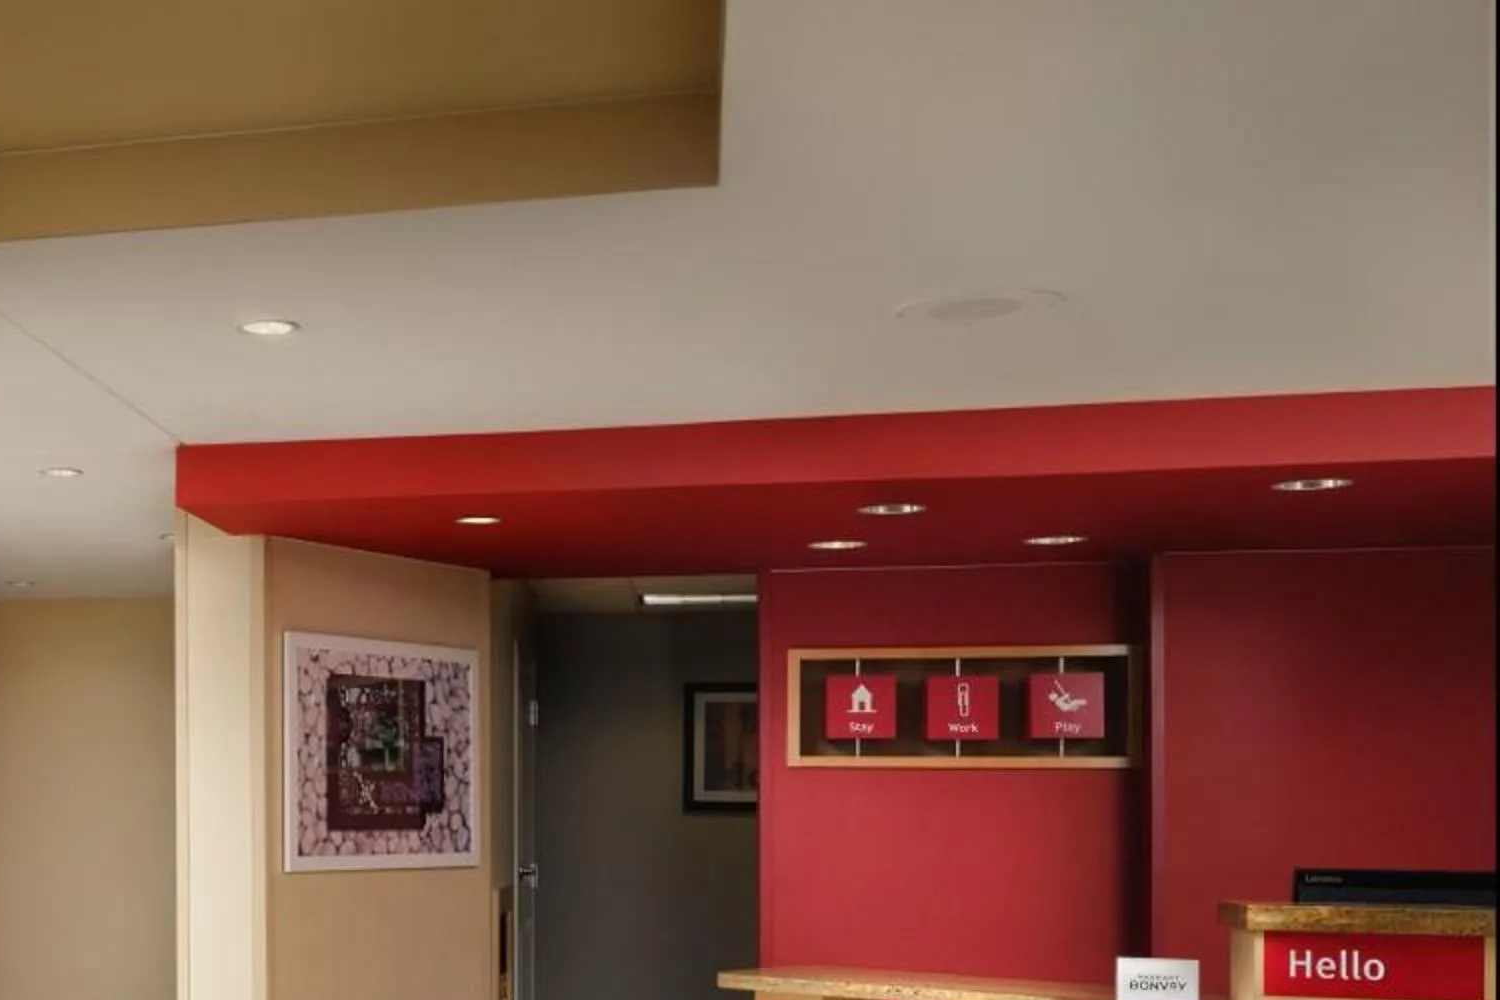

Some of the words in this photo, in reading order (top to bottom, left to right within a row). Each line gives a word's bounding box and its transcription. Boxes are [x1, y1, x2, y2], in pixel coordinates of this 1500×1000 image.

[849, 722, 874, 734] Stay
[949, 722, 979, 734] Work
[1055, 721, 1081, 735] Play
[1288, 949, 1386, 982] Hello
